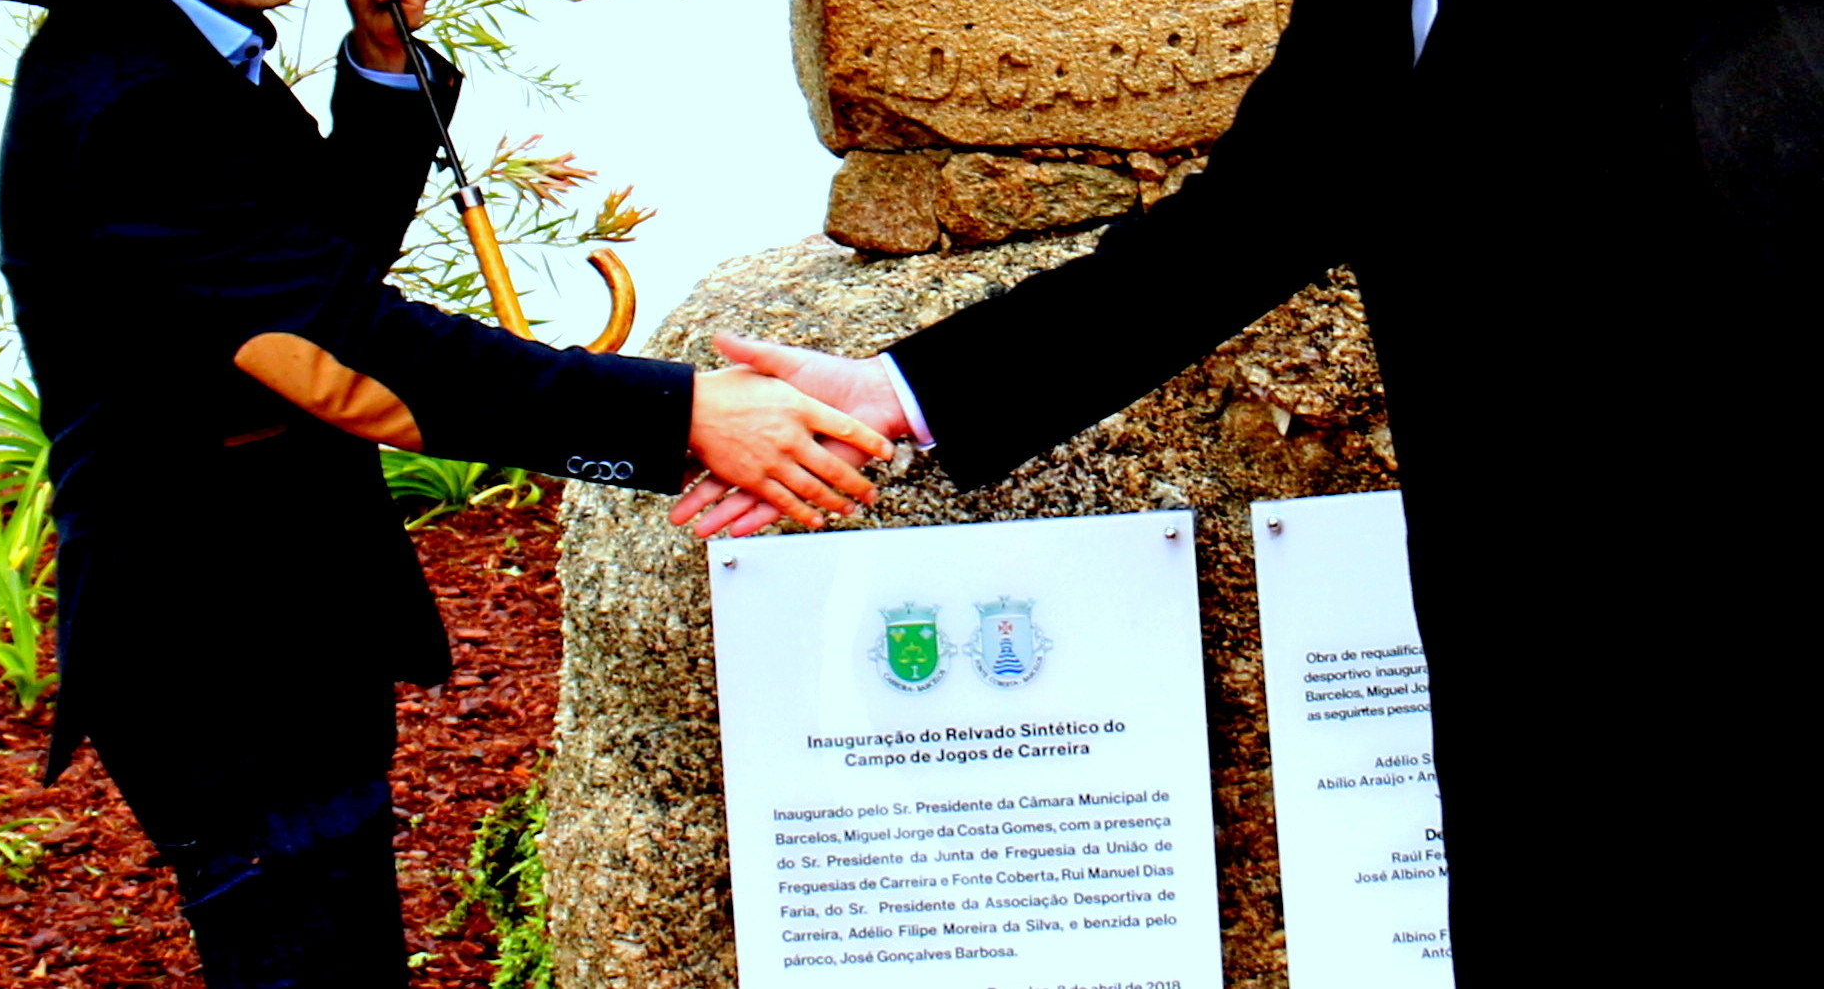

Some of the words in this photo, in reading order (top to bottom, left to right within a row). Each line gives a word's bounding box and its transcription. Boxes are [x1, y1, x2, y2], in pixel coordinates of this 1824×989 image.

[1306, 651, 1337, 664] Obra
[1341, 649, 1357, 661] de
[1303, 667, 1371, 684] desportivo
[1305, 688, 1364, 703] Barcelos,
[1366, 683, 1408, 698] Miguel
[1307, 712, 1322, 722] as
[1324, 706, 1384, 721] seguintes
[807, 730, 915, 749] Inauguração
[919, 729, 941, 743] do
[945, 724, 1016, 742] Relvado
[1020, 720, 1099, 738] Sintético
[1104, 719, 1125, 733] do
[845, 752, 906, 768] Campo
[910, 750, 931, 762] de
[936, 748, 988, 764] Jogos
[992, 746, 1013, 759] de
[1018, 742, 1090, 758] Carreira
[1375, 754, 1418, 768] Adélio
[1317, 777, 1356, 790] Abílio
[1359, 773, 1405, 787] Araújo
[773, 806, 854, 822] Inaugurado
[857, 804, 889, 819] pelo
[893, 802, 912, 815] Sr.
[915, 799, 993, 815] Presidente
[997, 797, 1015, 810] da
[1018, 794, 1074, 810] Câmara
[1078, 790, 1147, 807] Municipal
[1151, 789, 1170, 802] de
[775, 831, 842, 846] Barcelos,
[843, 828, 891, 844] Miguel
[893, 827, 934, 841] Jorge
[937, 824, 954, 838] da
[957, 822, 999, 837] Costa
[1002, 820, 1057, 835] Gomes,
[1059, 819, 1090, 832] com
[1093, 819, 1102, 830] a
[1104, 816, 1171, 832] presença
[776, 857, 795, 870] do
[801, 856, 820, 869] Sr.
[826, 852, 903, 868] Presidente
[910, 851, 928, 864] da
[934, 849, 974, 863] Junta
[980, 847, 998, 861] de
[1005, 843, 1076, 860] Freguesia
[1082, 843, 1100, 855] da
[1106, 840, 1148, 855] União
[1154, 839, 1173, 852] de
[1391, 850, 1422, 863] Raúl
[778, 879, 856, 895] Freguesias
[859, 878, 876, 891] de
[879, 875, 937, 890] Carreira
[940, 877, 949, 887] e
[952, 872, 993, 886] Fonte
[996, 869, 1060, 884] Coberta,
[1061, 867, 1085, 881] Rui
[1088, 865, 1140, 880] Manuel
[1143, 863, 1174, 877] Dias
[1354, 870, 1388, 884] José
[1391, 868, 1435, 881] Albino
[780, 905, 820, 919] Faria,
[825, 904, 843, 916] do
[848, 902, 868, 916] Sr.
[879, 899, 956, 914] Presidente
[961, 897, 979, 910] da
[985, 894, 1068, 909] Associação
[1074, 890, 1151, 906] Desportiva
[1157, 888, 1175, 901] de
[782, 927, 843, 942] Carreira,
[848, 925, 893, 940] Adélio
[898, 924, 937, 938] Filipe
[943, 921, 997, 936] Moreira
[1002, 920, 1020, 933] da
[1026, 917, 1064, 932] Silva,
[1069, 919, 1078, 929] e
[1083, 915, 1140, 930] benzida
[1145, 913, 1177, 929] pelo
[1392, 931, 1436, 944] Albino
[783, 954, 837, 969] pároco,
[840, 950, 874, 964] José
[877, 948, 951, 965] Gonçalves
[955, 945, 1018, 960] Barbosa.
